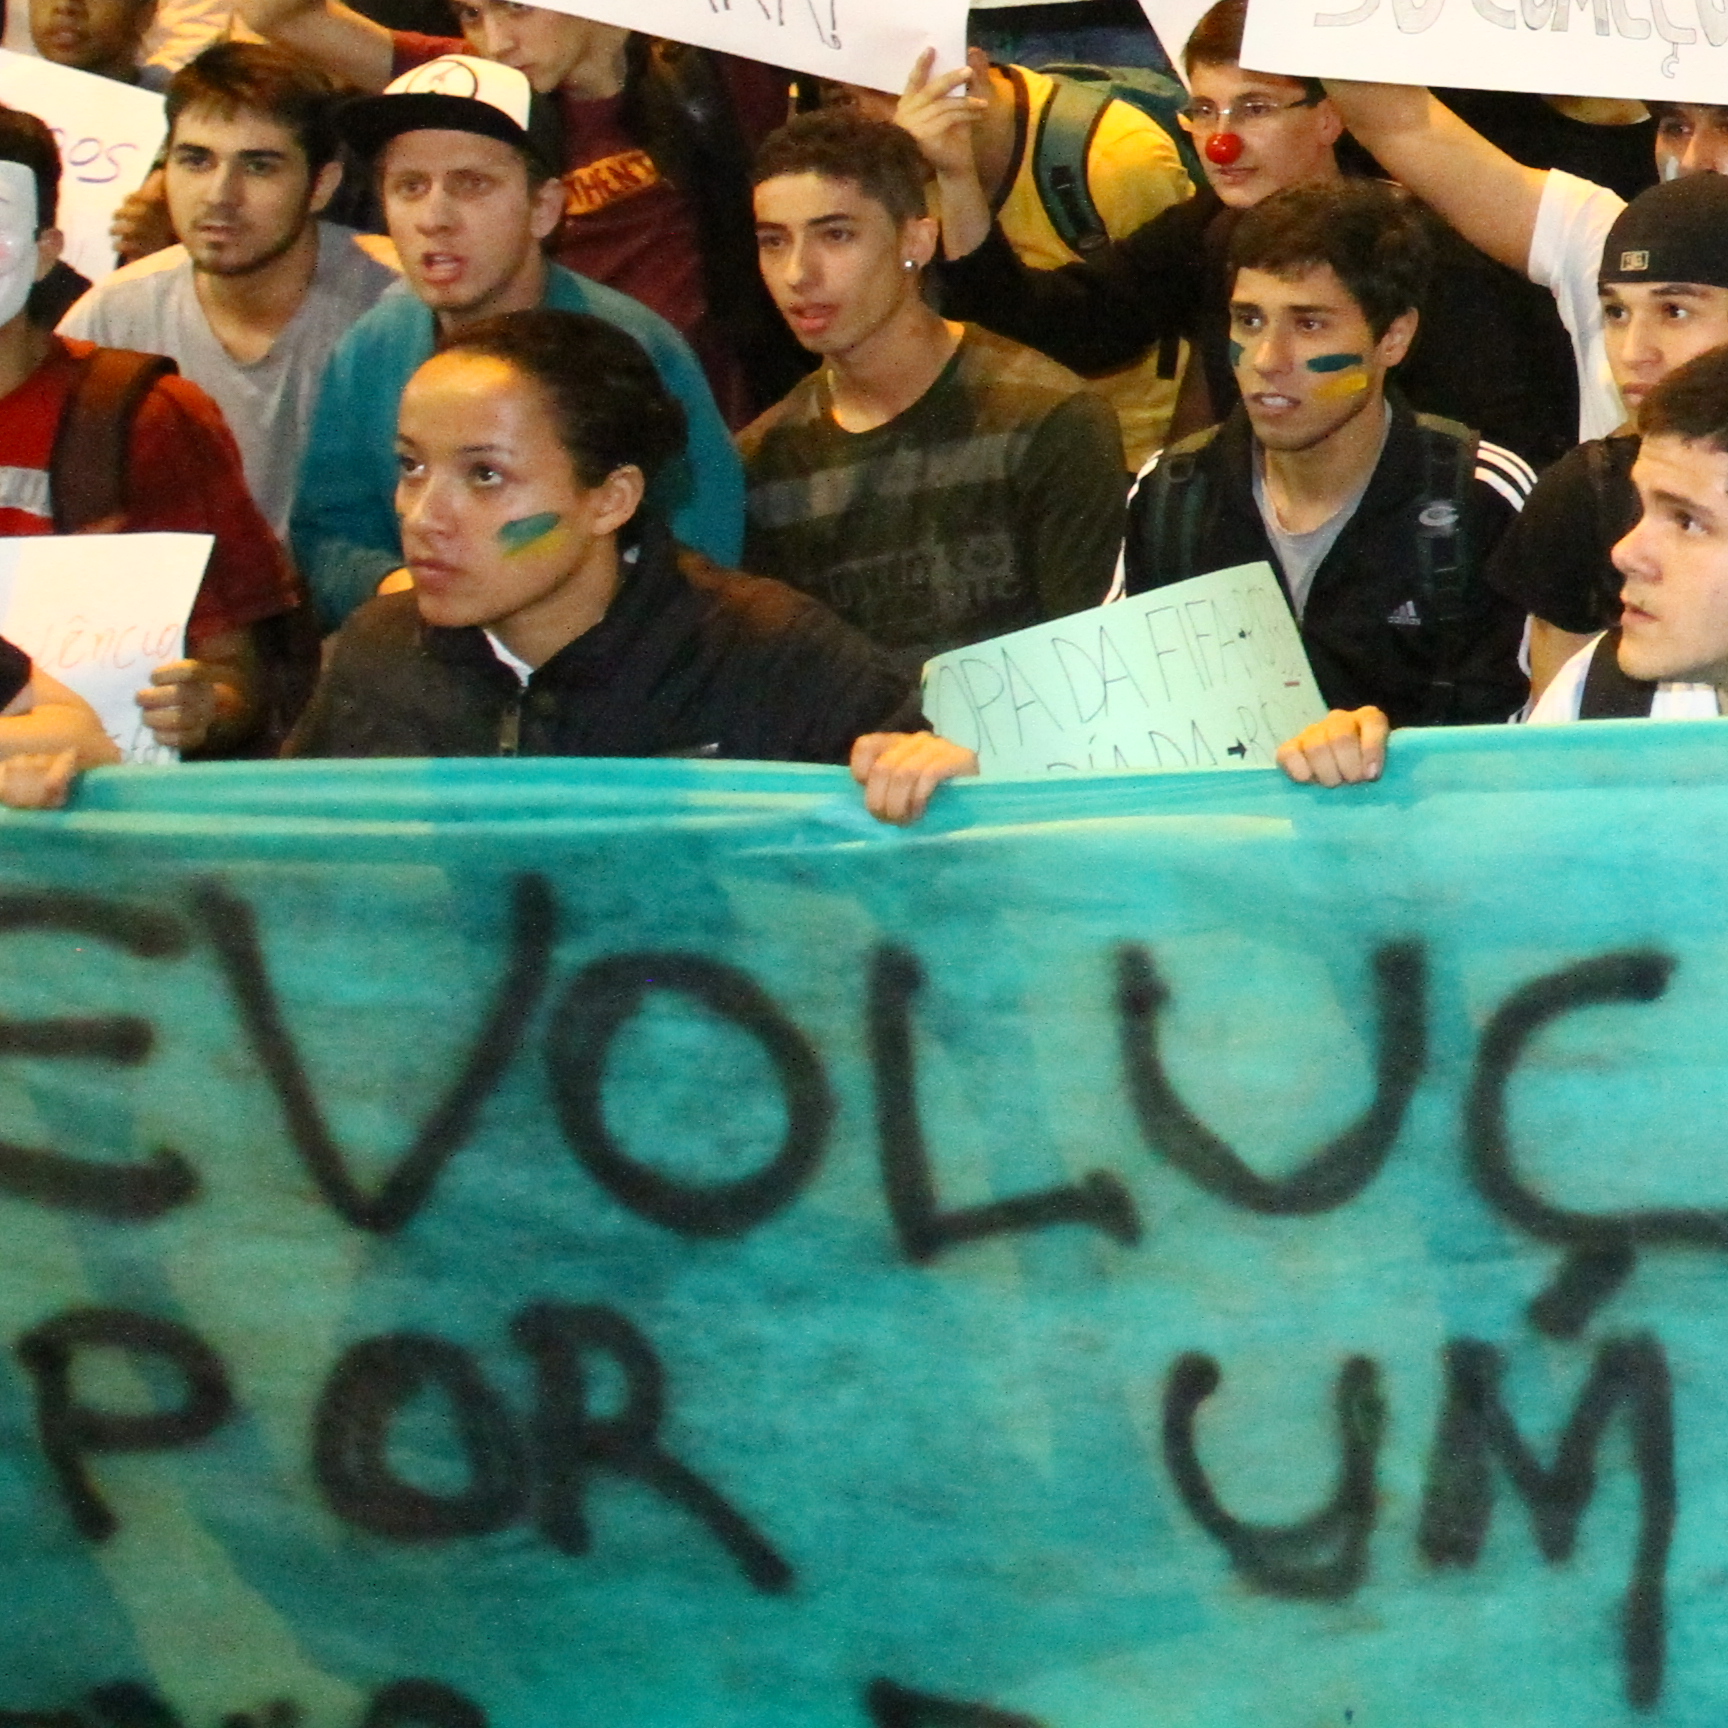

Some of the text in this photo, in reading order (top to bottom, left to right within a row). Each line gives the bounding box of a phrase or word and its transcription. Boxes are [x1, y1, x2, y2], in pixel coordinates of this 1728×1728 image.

[1050, 624, 1150, 725] DA
[1144, 597, 1238, 703] FIFA
[12, 1296, 1676, 1709] POR UM
